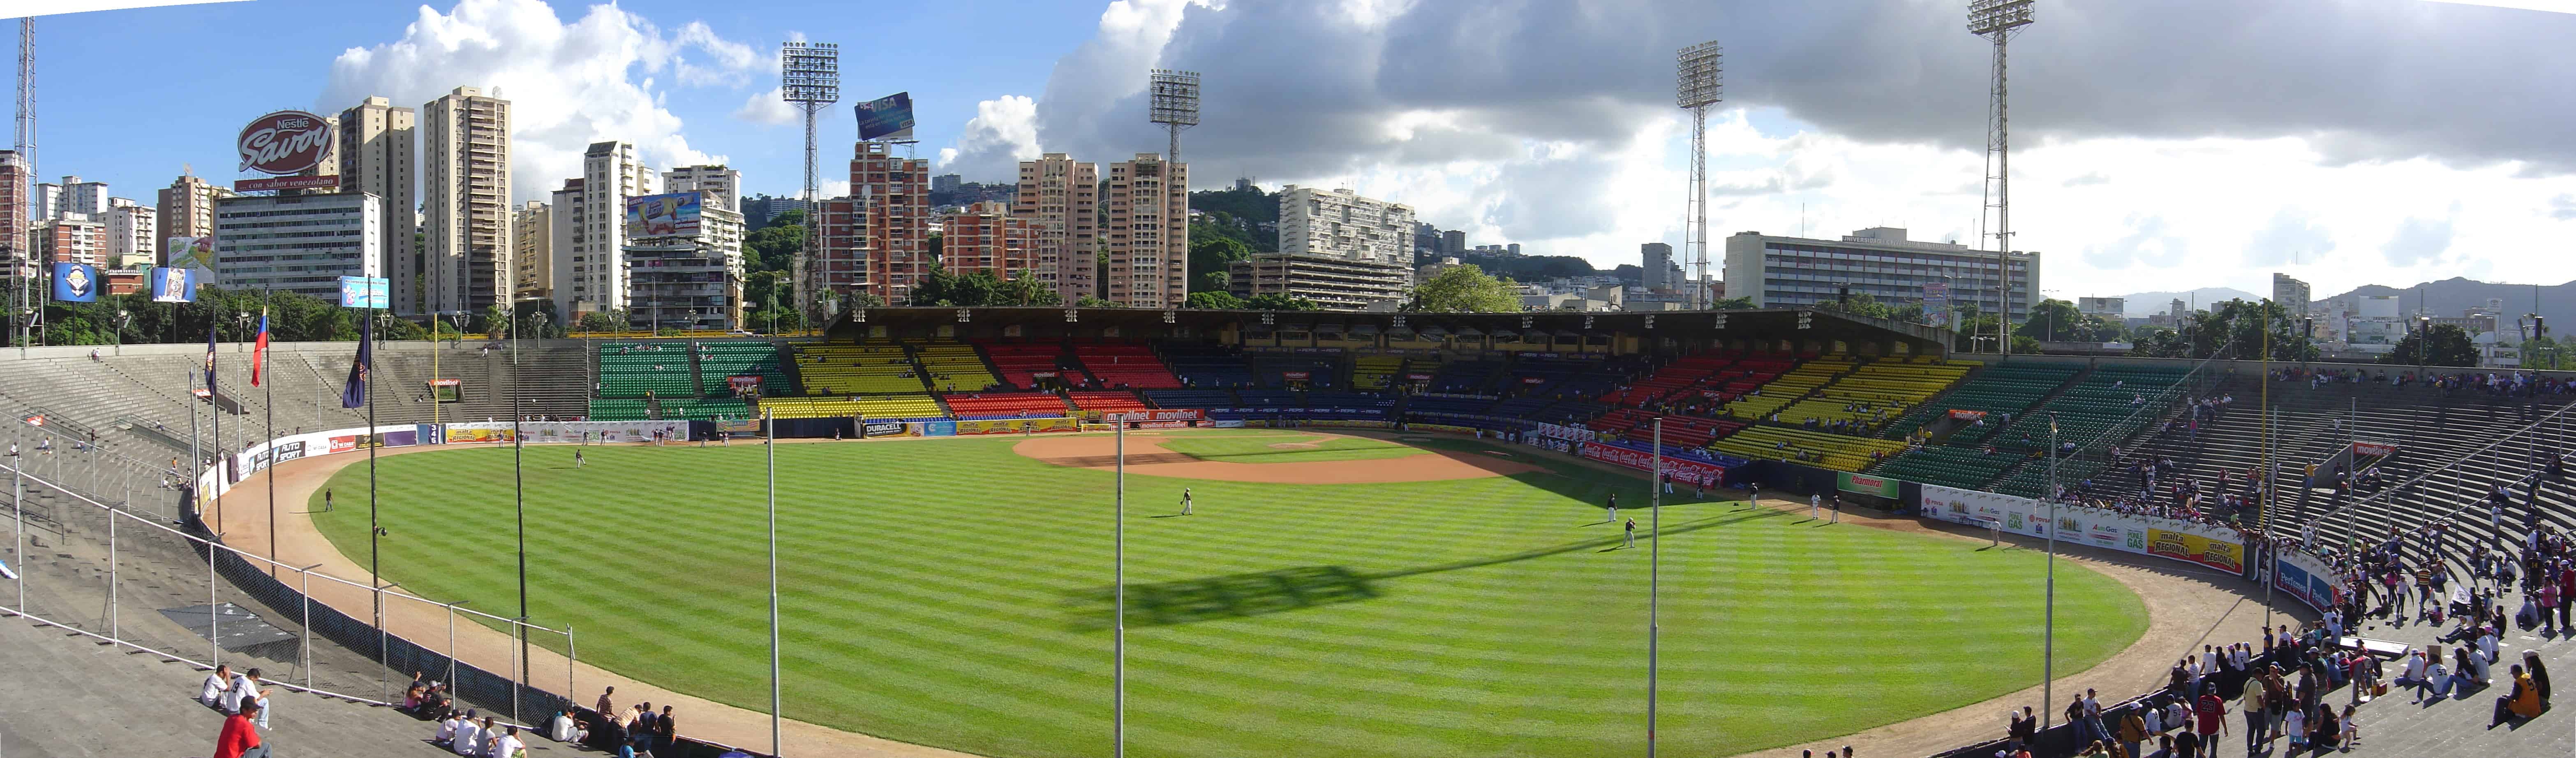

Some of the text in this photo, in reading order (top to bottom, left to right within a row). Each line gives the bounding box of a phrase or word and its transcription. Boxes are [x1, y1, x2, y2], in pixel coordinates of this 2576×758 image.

[872, 97, 897, 112] VISA
[239, 123, 333, 172] Savoy
[290, 177, 333, 187] venezolano
[1107, 411, 1149, 420] mvilnet
[1156, 411, 1197, 420] movilnet
[866, 423, 901, 432] DURACELL
[282, 441, 300, 452] AUTO
[280, 450, 301, 461] SPORT
[1851, 475, 1883, 487] Pharmorat
[2008, 519, 2022, 529] GAS
[2128, 531, 2143, 540] PONLE
[2160, 533, 2184, 542] malta
[2127, 538, 2143, 549] GAS
[2210, 542, 2231, 553] malta
[2155, 541, 2190, 558] REGIONAL
[2204, 551, 2235, 569] REGIONAL
[2281, 572, 2306, 592] Perfumes
[2201, 700, 2215, 712] 23
